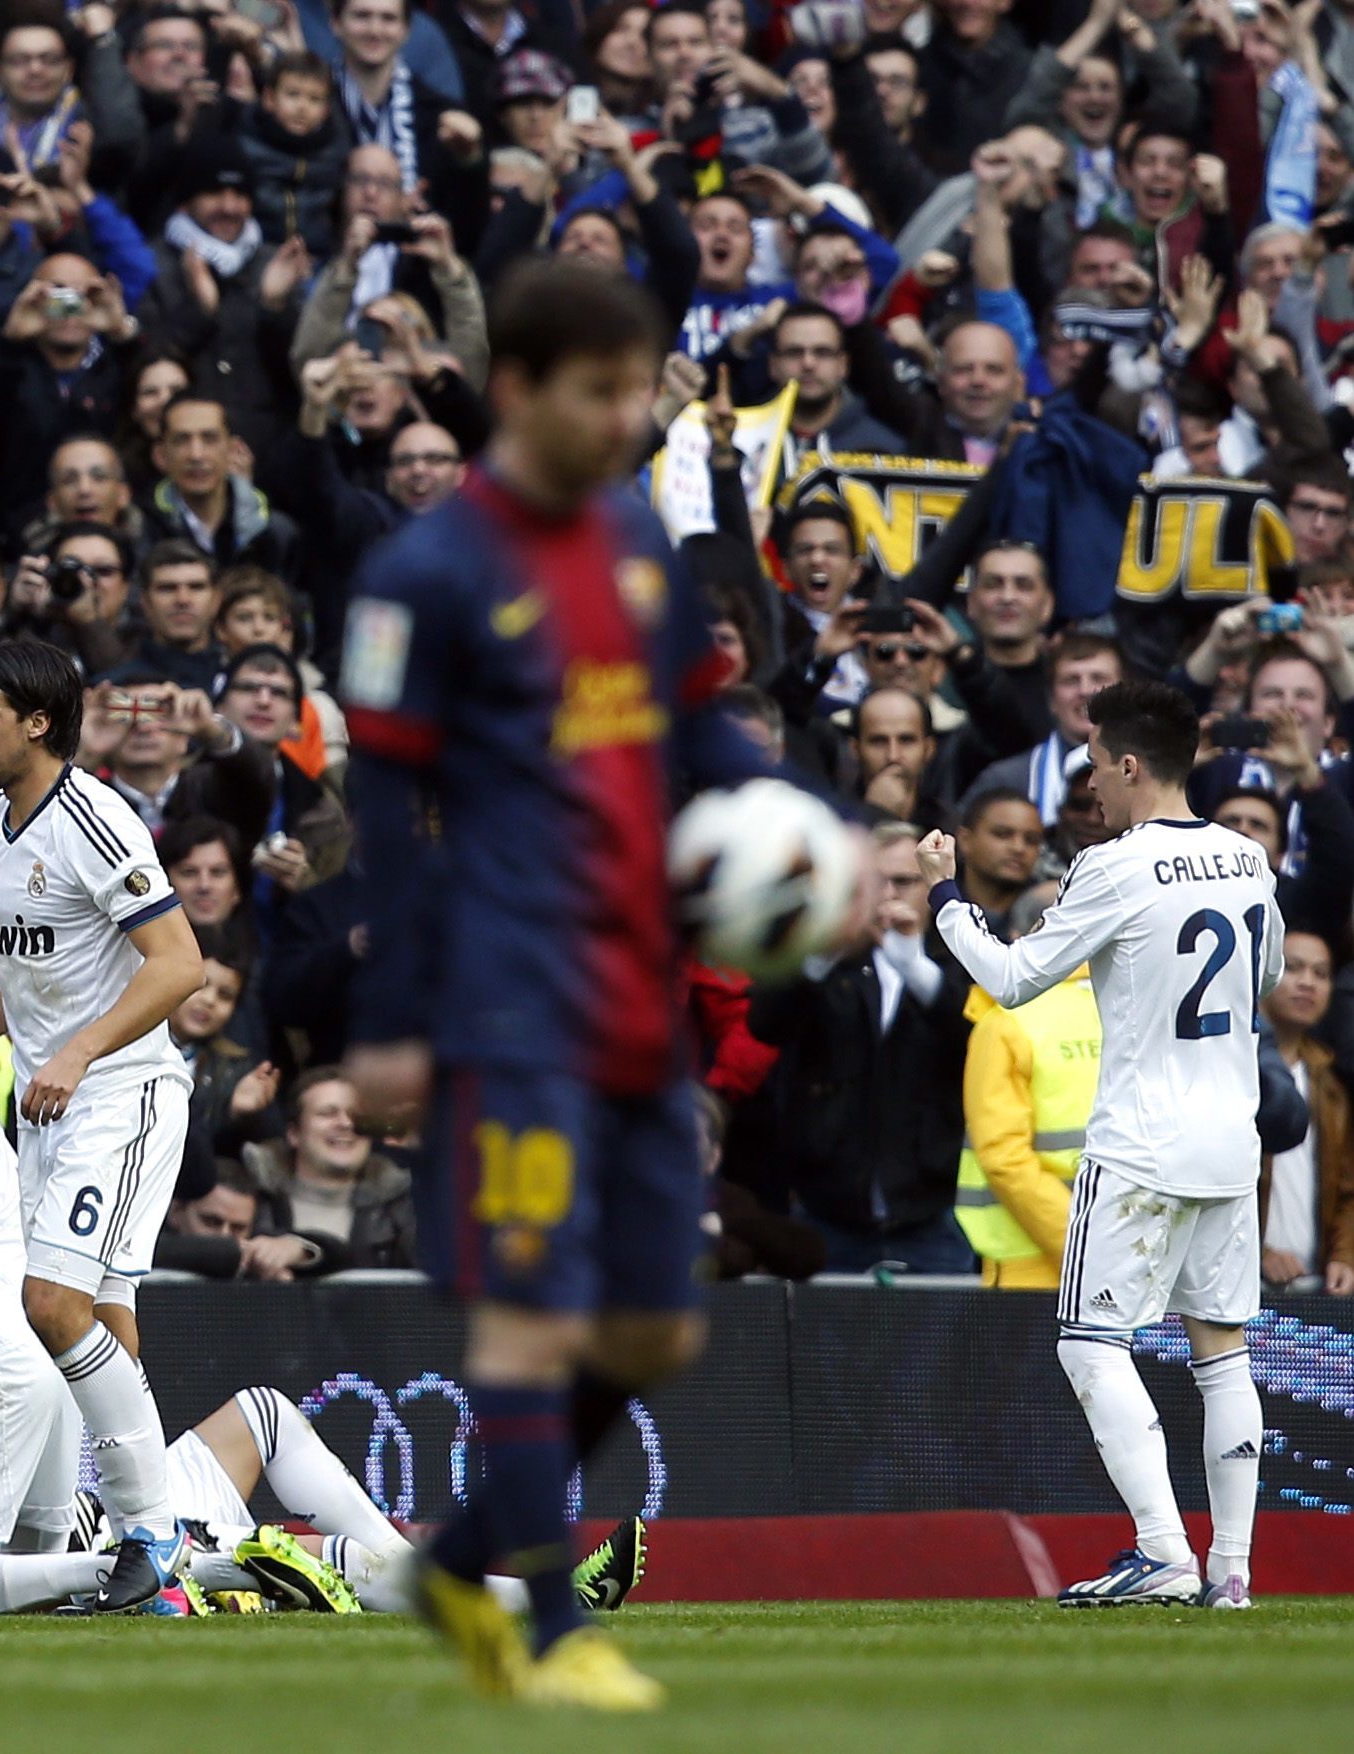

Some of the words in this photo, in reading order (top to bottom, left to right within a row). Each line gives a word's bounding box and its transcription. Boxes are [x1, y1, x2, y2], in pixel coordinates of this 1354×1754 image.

[1175, 903, 1265, 1040] 21
[68, 1185, 104, 1237] 6
[472, 1119, 575, 1226] 10
